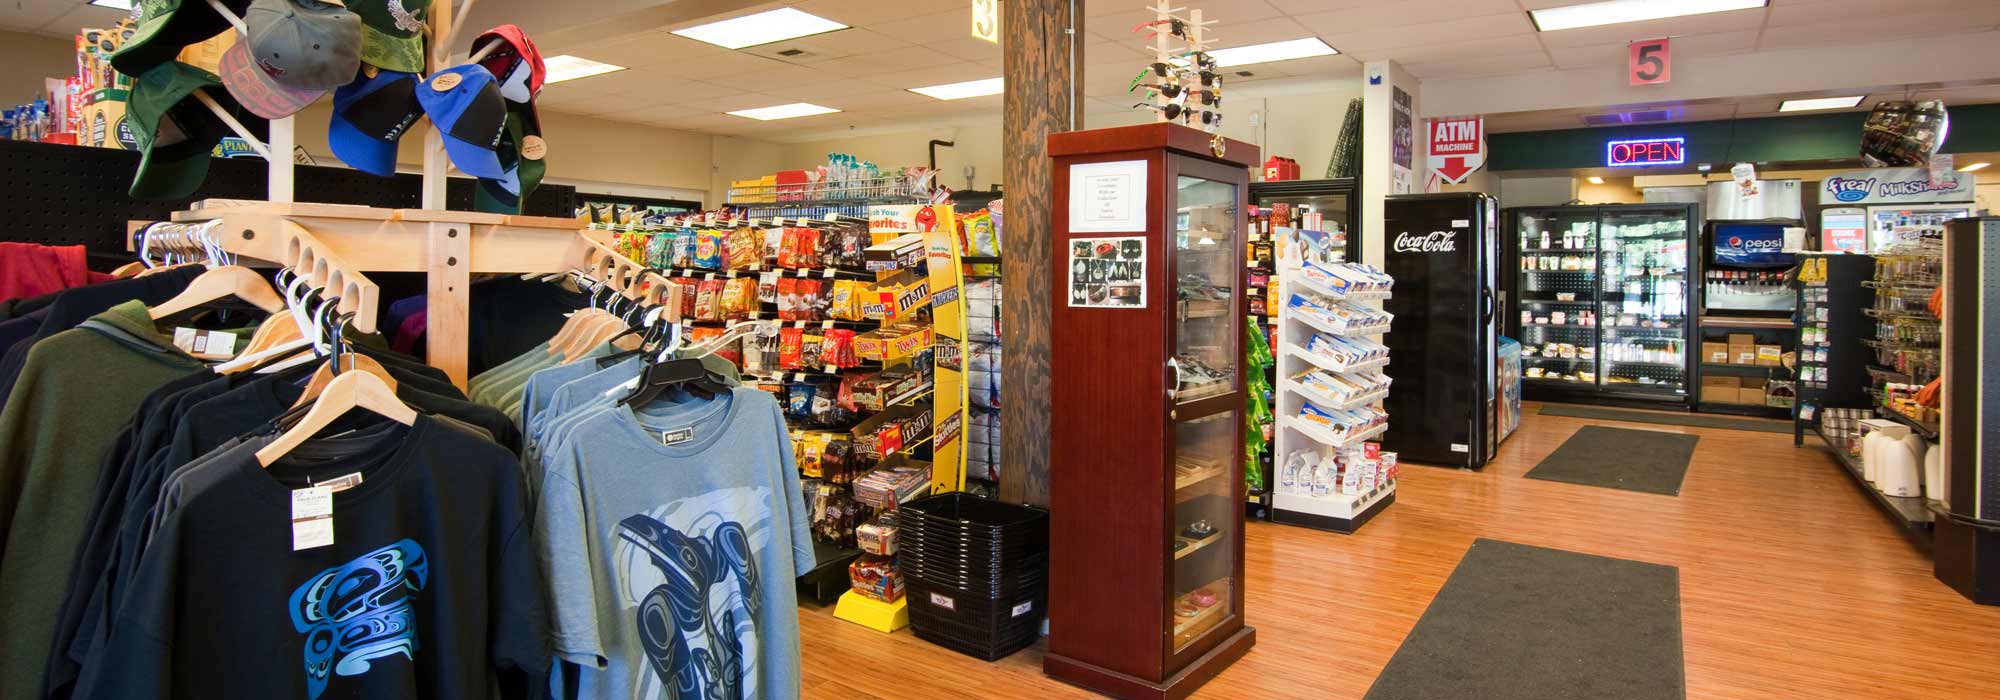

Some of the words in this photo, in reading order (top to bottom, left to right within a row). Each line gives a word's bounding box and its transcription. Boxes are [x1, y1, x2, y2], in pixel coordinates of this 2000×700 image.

[1636, 44, 1664, 81] 5
[1434, 121, 1476, 143] ATM
[223, 140, 256, 153] PLANT
[1436, 143, 1474, 152] MACHINE
[1612, 141, 1681, 163] OPEN
[1745, 238, 1782, 253] pepsi
